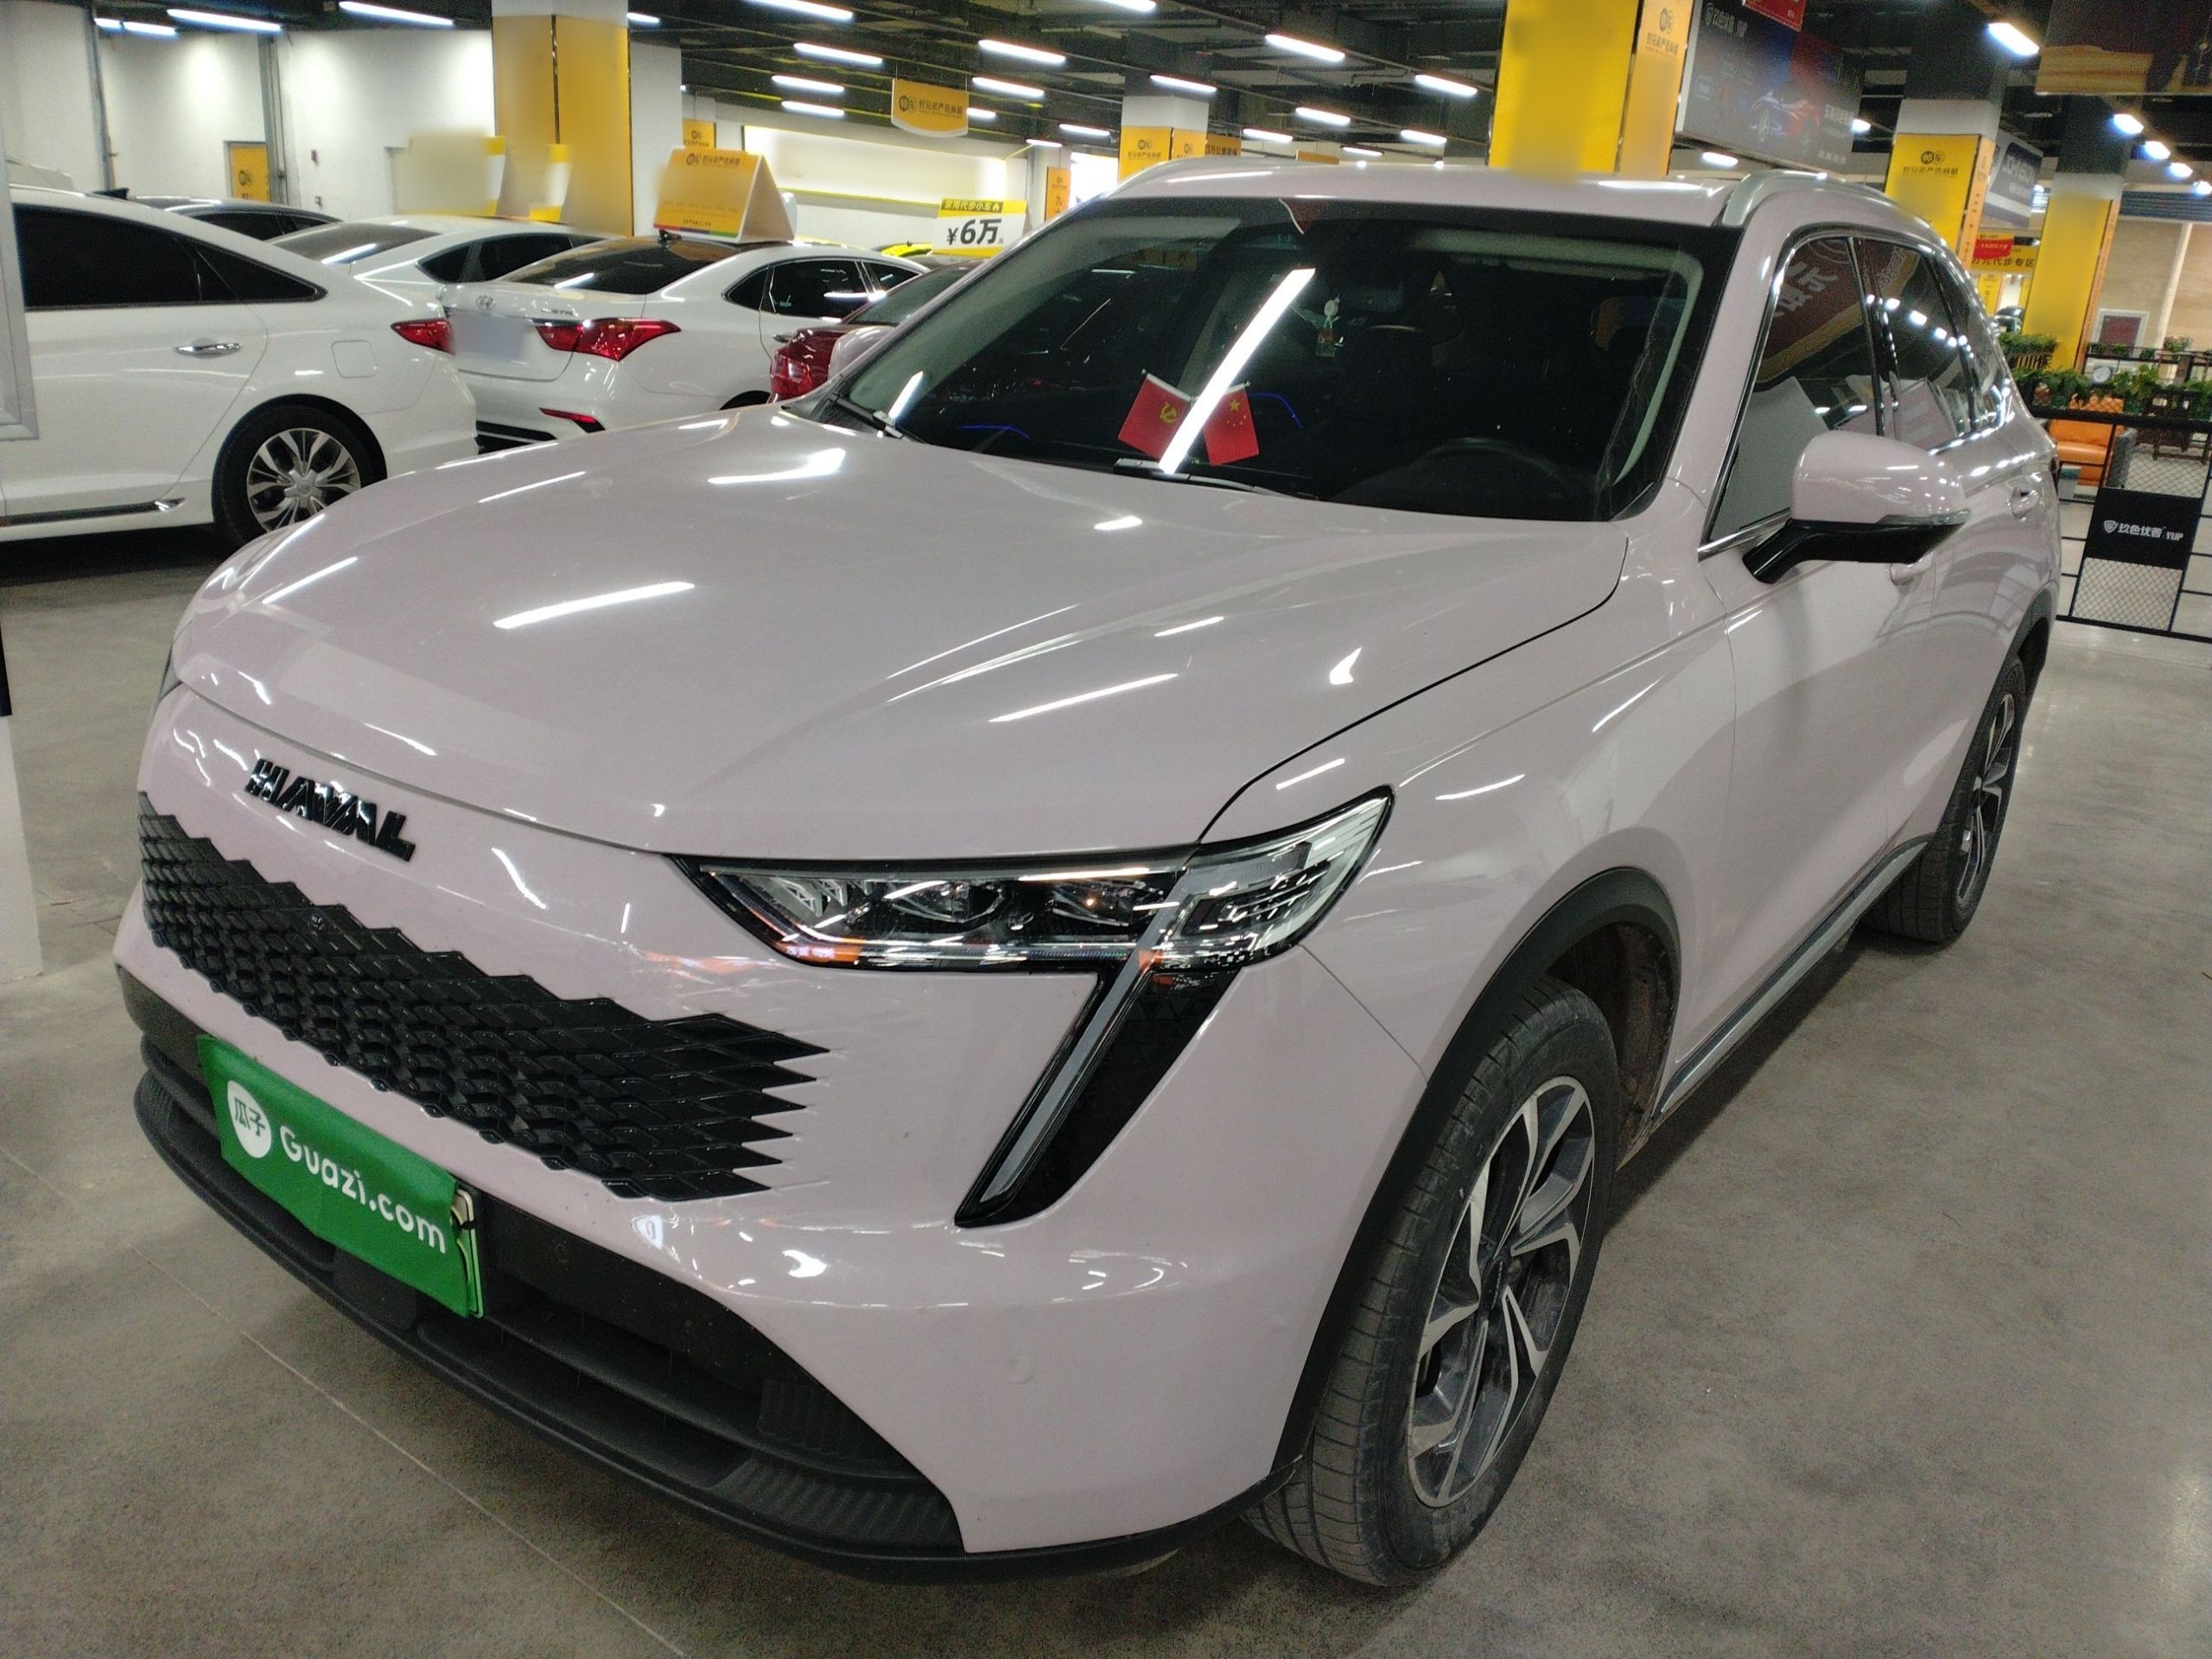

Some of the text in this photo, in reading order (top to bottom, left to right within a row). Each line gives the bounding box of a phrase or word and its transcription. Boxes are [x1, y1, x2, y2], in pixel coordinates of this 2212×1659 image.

[245, 758, 416, 862] HAVAL
[234, 1096, 266, 1137] 瓜子
[280, 1125, 446, 1254] Guazi.com
